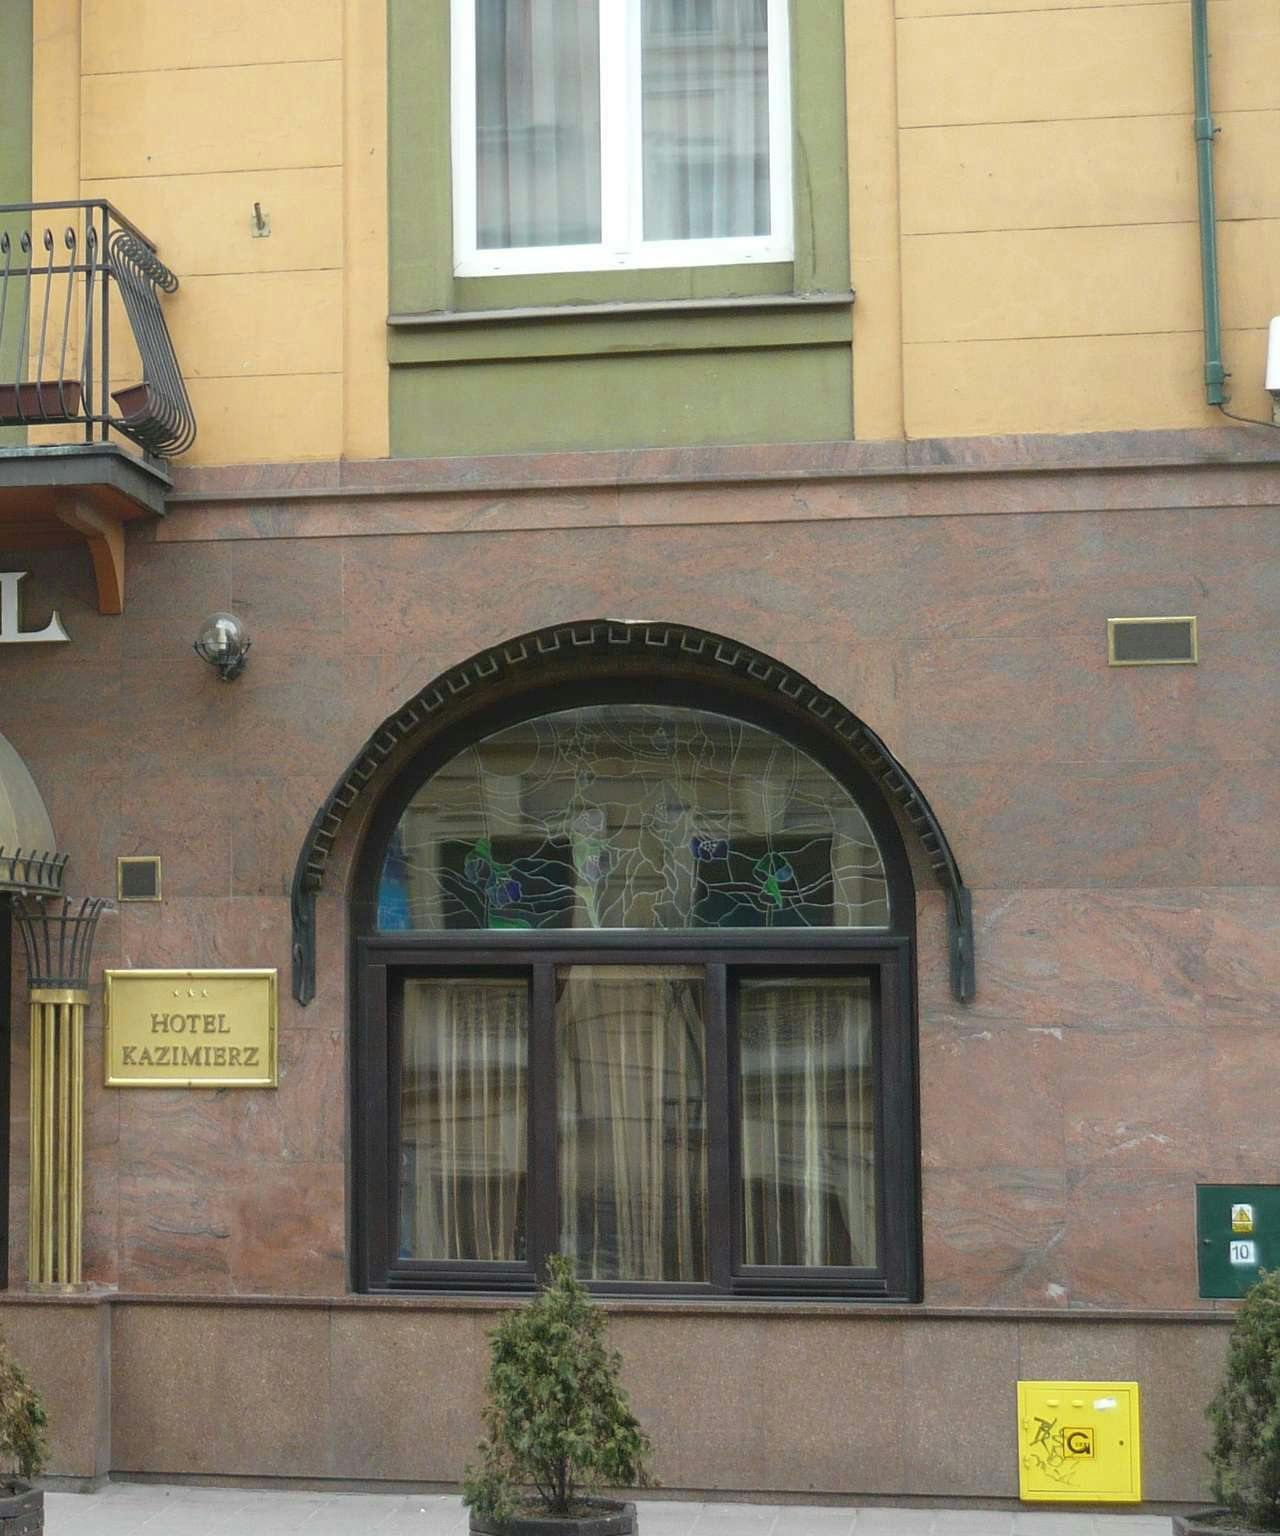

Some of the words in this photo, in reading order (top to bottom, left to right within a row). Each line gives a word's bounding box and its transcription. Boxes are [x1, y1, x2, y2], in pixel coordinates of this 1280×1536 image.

[150, 1013, 231, 1034] HOTEL
[122, 1045, 261, 1067] KAZIMIERZ
[1231, 1244, 1249, 1260] 10
